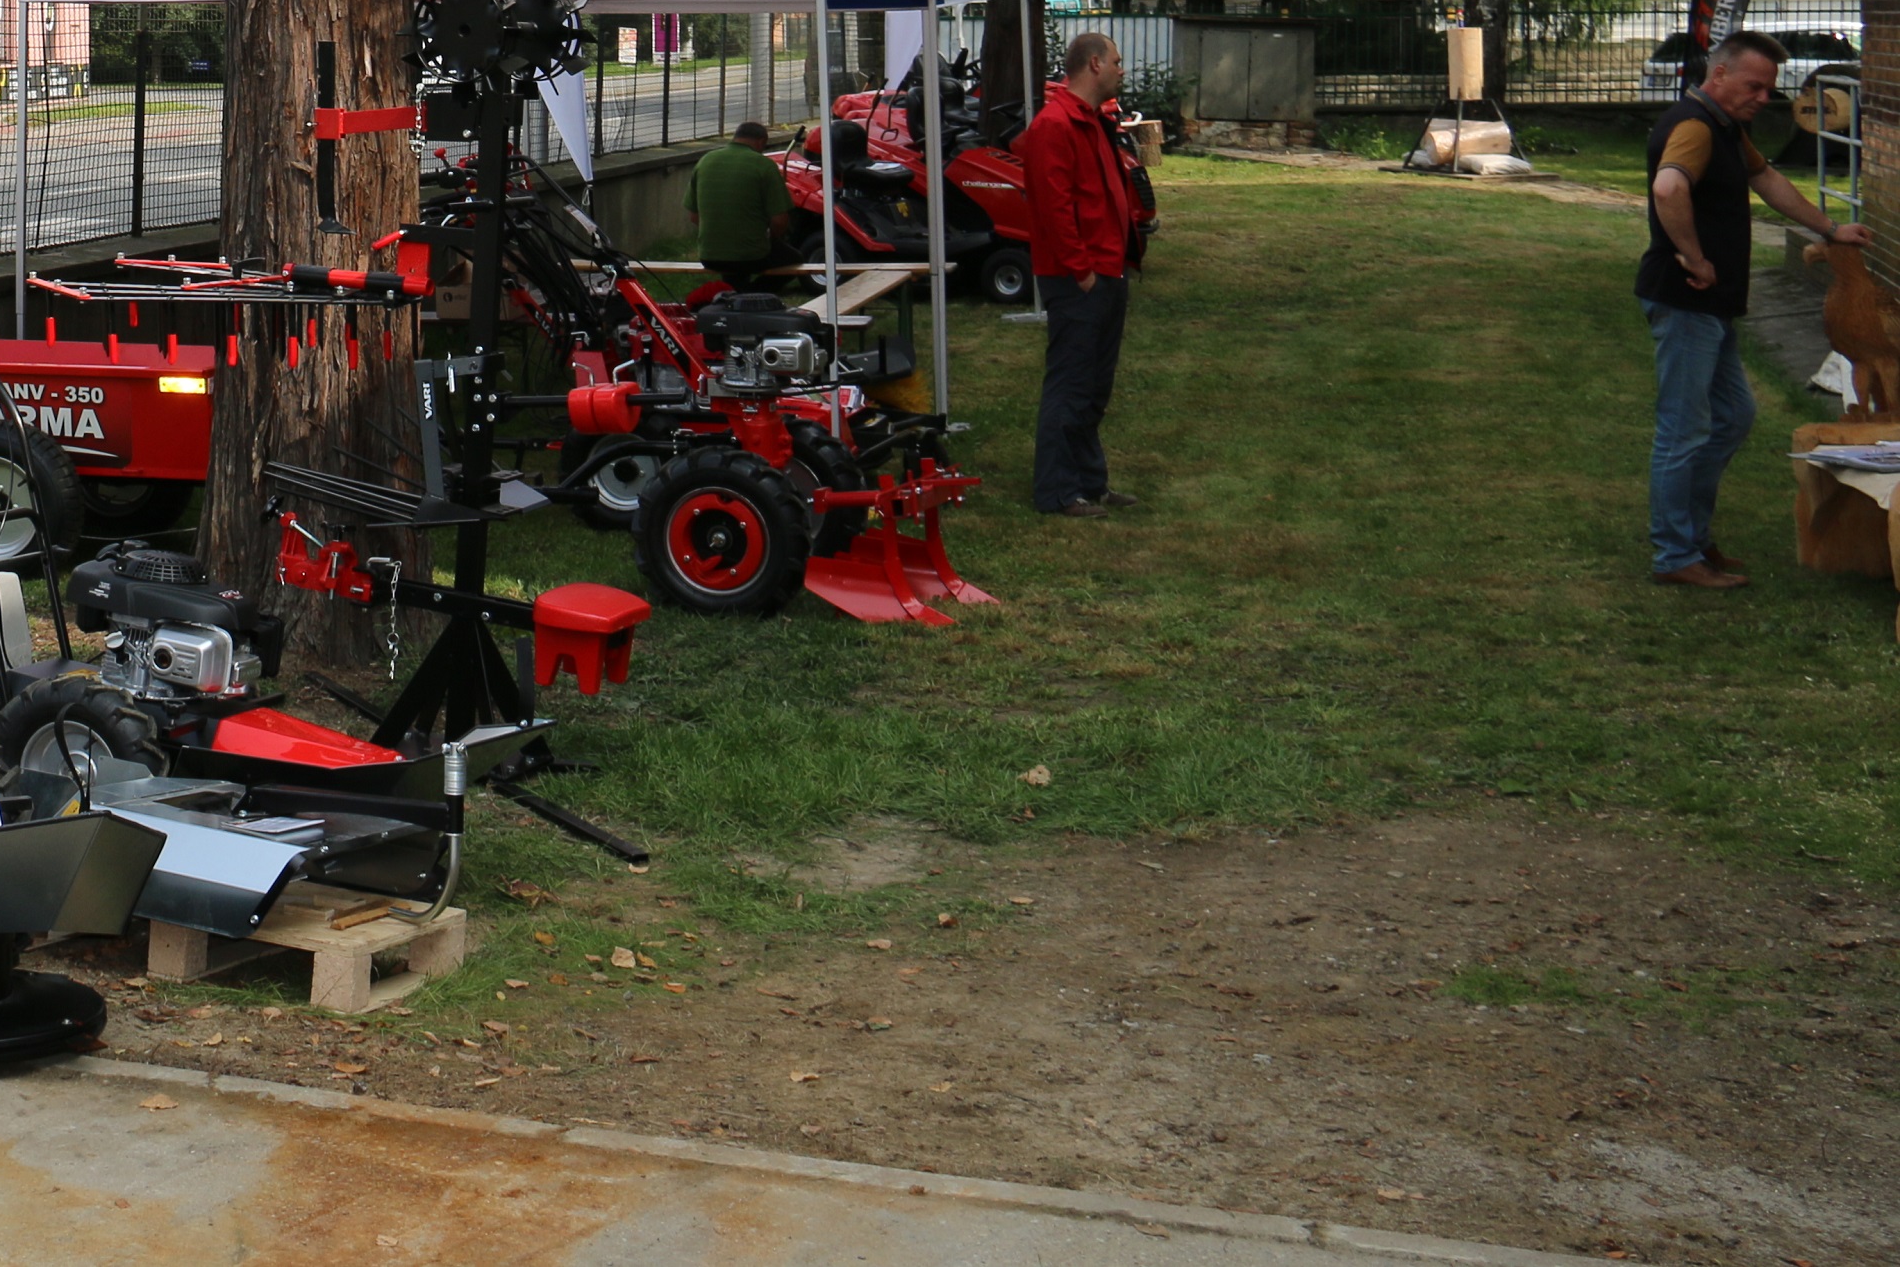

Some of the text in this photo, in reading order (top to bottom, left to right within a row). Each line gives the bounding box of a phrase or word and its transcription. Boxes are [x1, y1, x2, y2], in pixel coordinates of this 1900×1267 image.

[651, 315, 679, 357] VARI
[64, 386, 105, 404] 350
[423, 381, 433, 420] VARI
